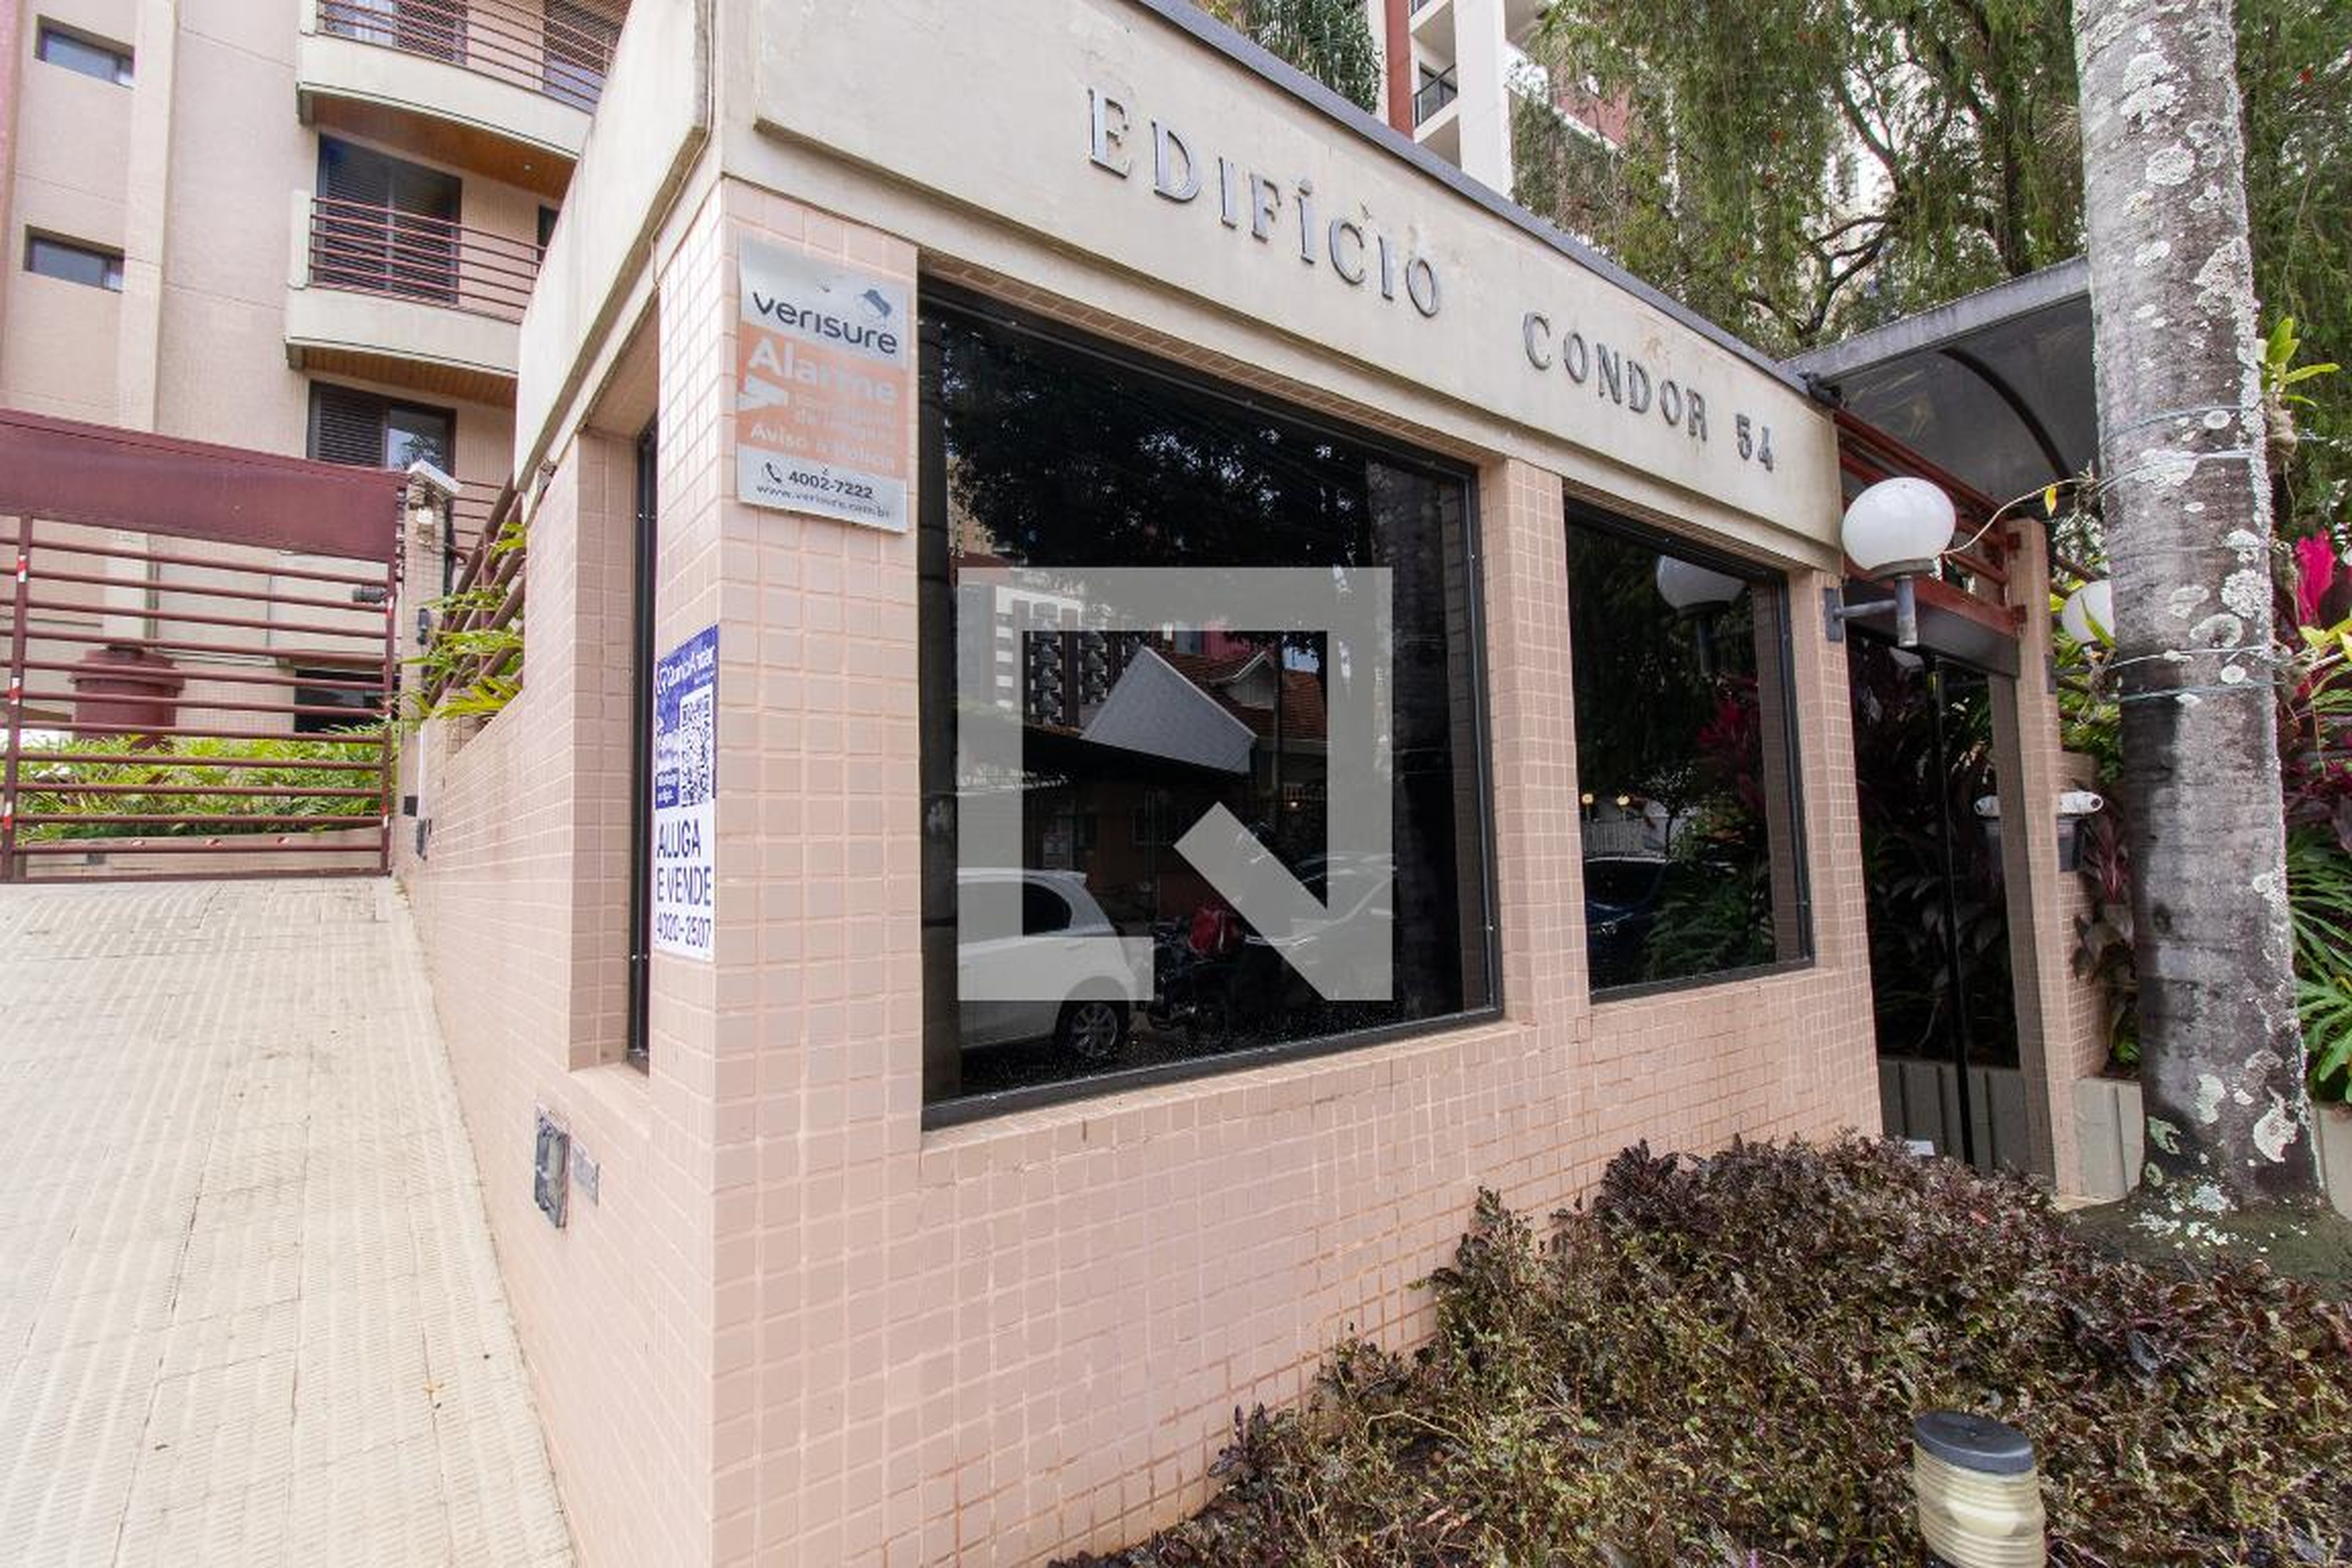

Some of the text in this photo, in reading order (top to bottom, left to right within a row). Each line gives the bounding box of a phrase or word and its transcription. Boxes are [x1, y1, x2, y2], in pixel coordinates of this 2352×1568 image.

[753, 292, 897, 354] verisure
[1525, 311, 1708, 442] CONDOR
[1735, 414, 1775, 473] 54
[788, 471, 873, 500] 4002-7222
[657, 819, 701, 859] ALUGA
[657, 865, 712, 906] E VENDE
